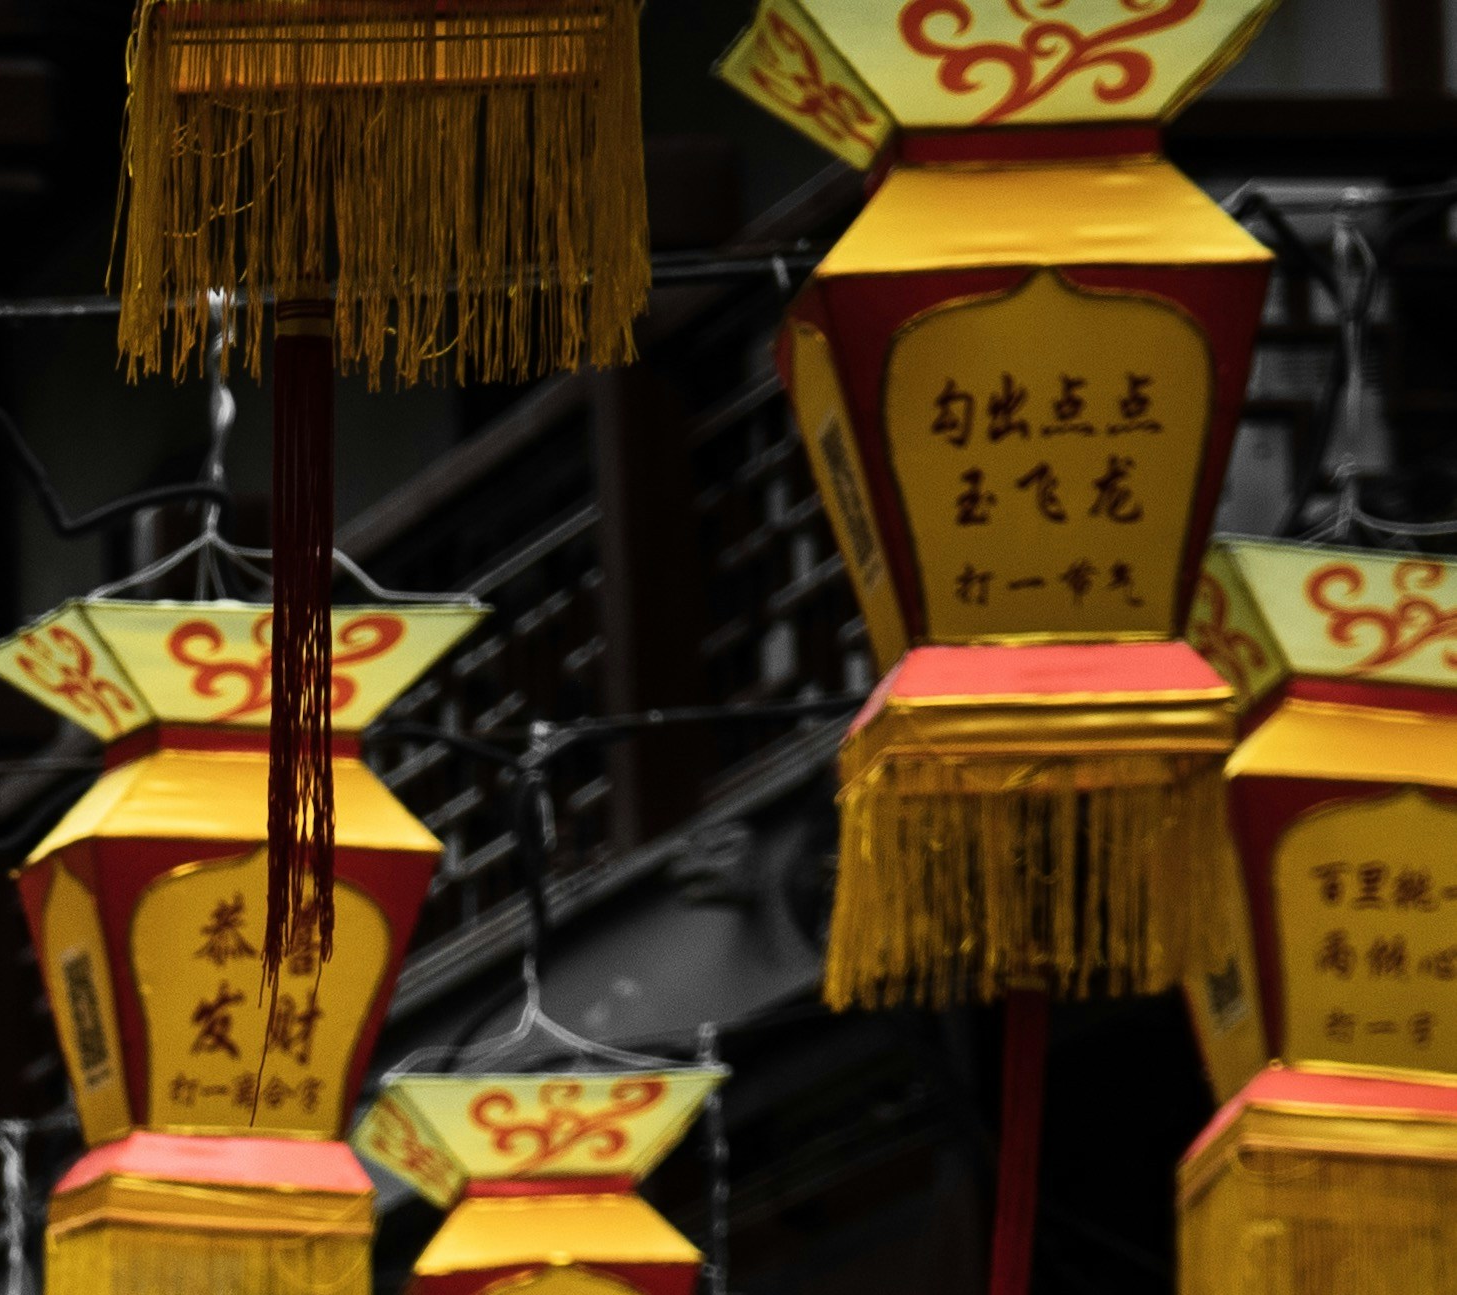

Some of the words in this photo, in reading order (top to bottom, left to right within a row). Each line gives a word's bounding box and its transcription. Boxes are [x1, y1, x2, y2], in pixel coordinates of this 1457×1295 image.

[956, 455, 1144, 525] 玉飞龙
[192, 980, 323, 1065] 发财
